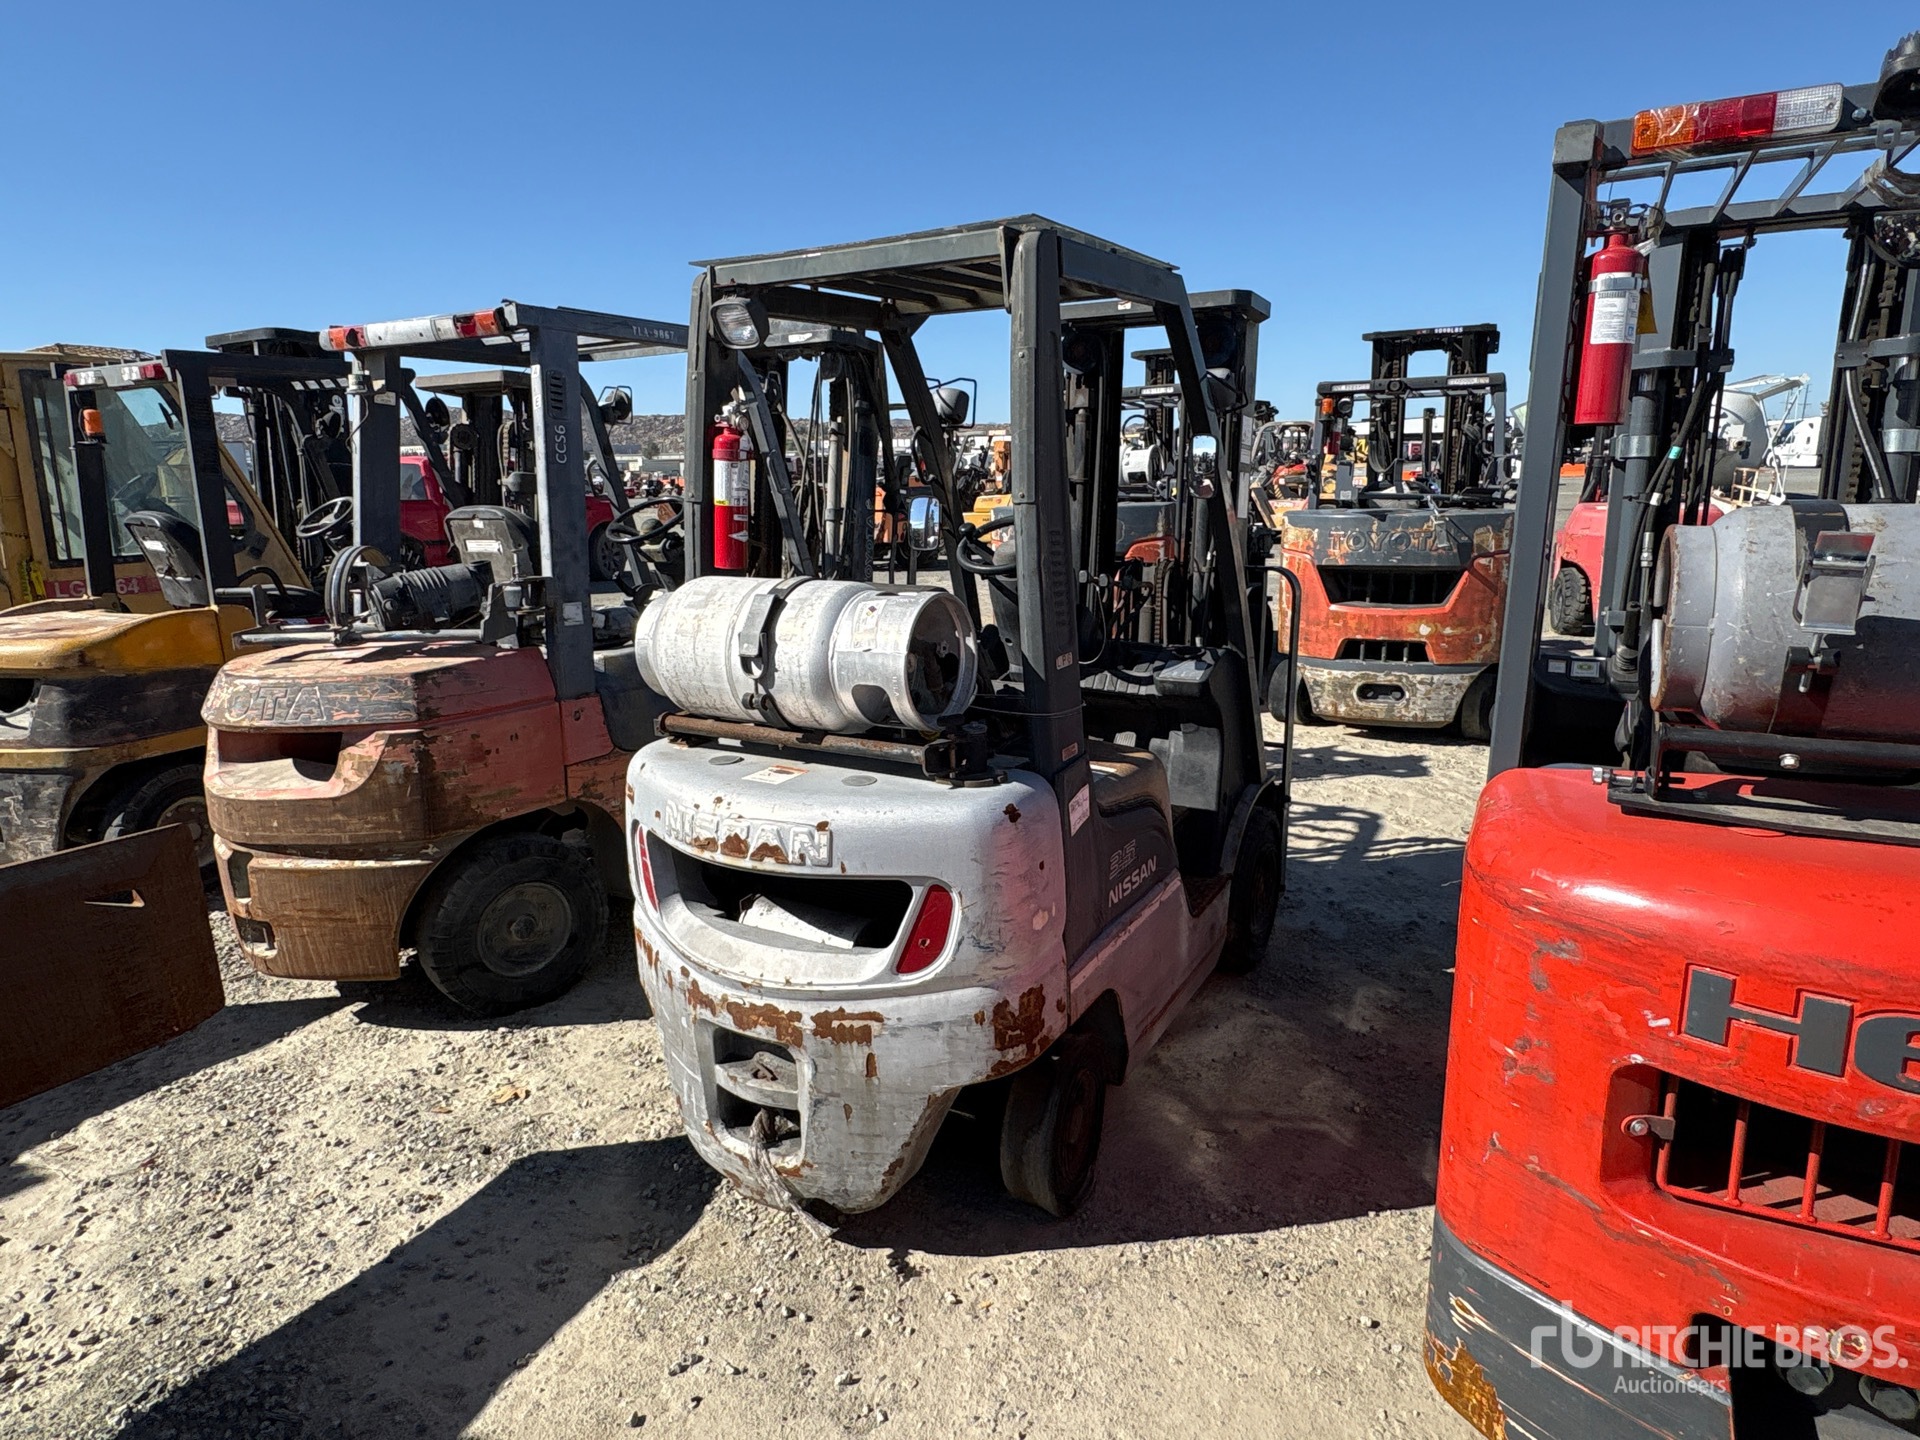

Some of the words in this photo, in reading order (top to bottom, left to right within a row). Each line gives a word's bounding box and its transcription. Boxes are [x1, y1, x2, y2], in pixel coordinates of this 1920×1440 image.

[554, 424, 567, 464] CCS6
[1328, 530, 1454, 553] TOYOTA
[665, 800, 833, 867] NISSAN
[1108, 855, 1157, 908] NISSAN
